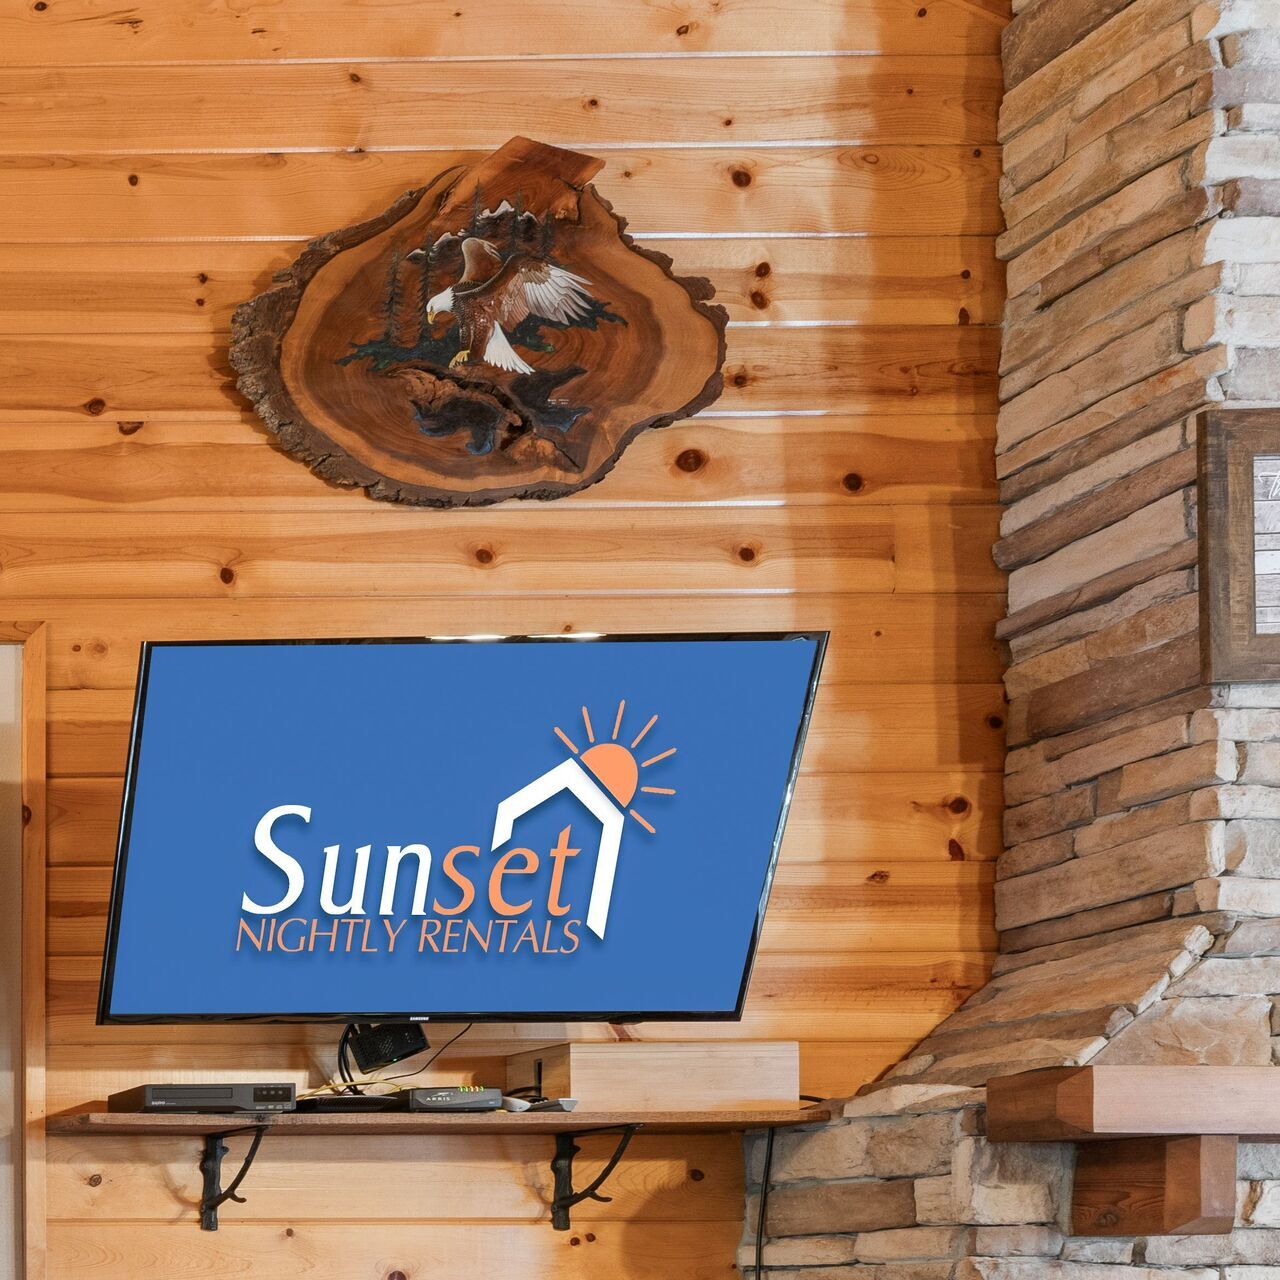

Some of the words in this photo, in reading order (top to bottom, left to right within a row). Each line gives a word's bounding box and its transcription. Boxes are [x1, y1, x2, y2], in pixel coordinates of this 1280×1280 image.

[241, 804, 582, 916] Sunset
[236, 918, 407, 953] NIGHTLY
[418, 918, 582, 953] RENTALS
